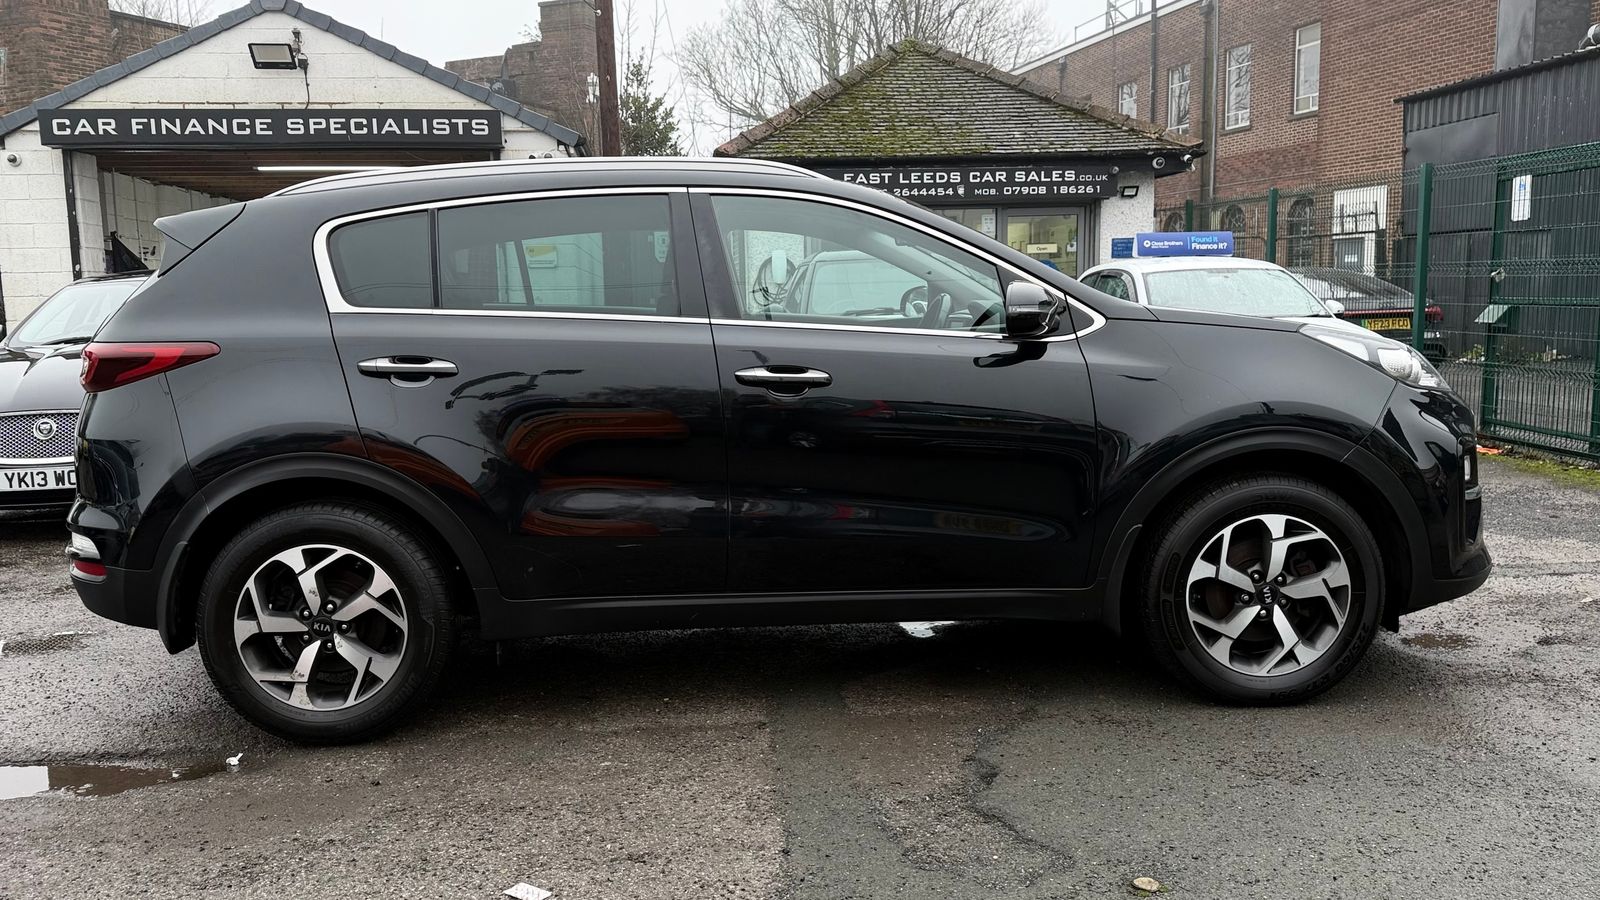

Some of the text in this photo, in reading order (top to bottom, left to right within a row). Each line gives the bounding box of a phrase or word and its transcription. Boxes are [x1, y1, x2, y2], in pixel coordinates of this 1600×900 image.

[52, 118, 489, 136] CAR FINANCE SPECIALISTS
[899, 171, 961, 184] LEEDS
[969, 171, 1007, 183] CAR
[893, 187, 954, 197] 2644454
[974, 188, 999, 196] MOB.
[1003, 186, 1047, 195] 07908
[1053, 185, 1100, 194] 186261
[4, 471, 48, 489] YK13
[1263, 586, 1273, 604] KIA
[313, 621, 331, 632] KIA
